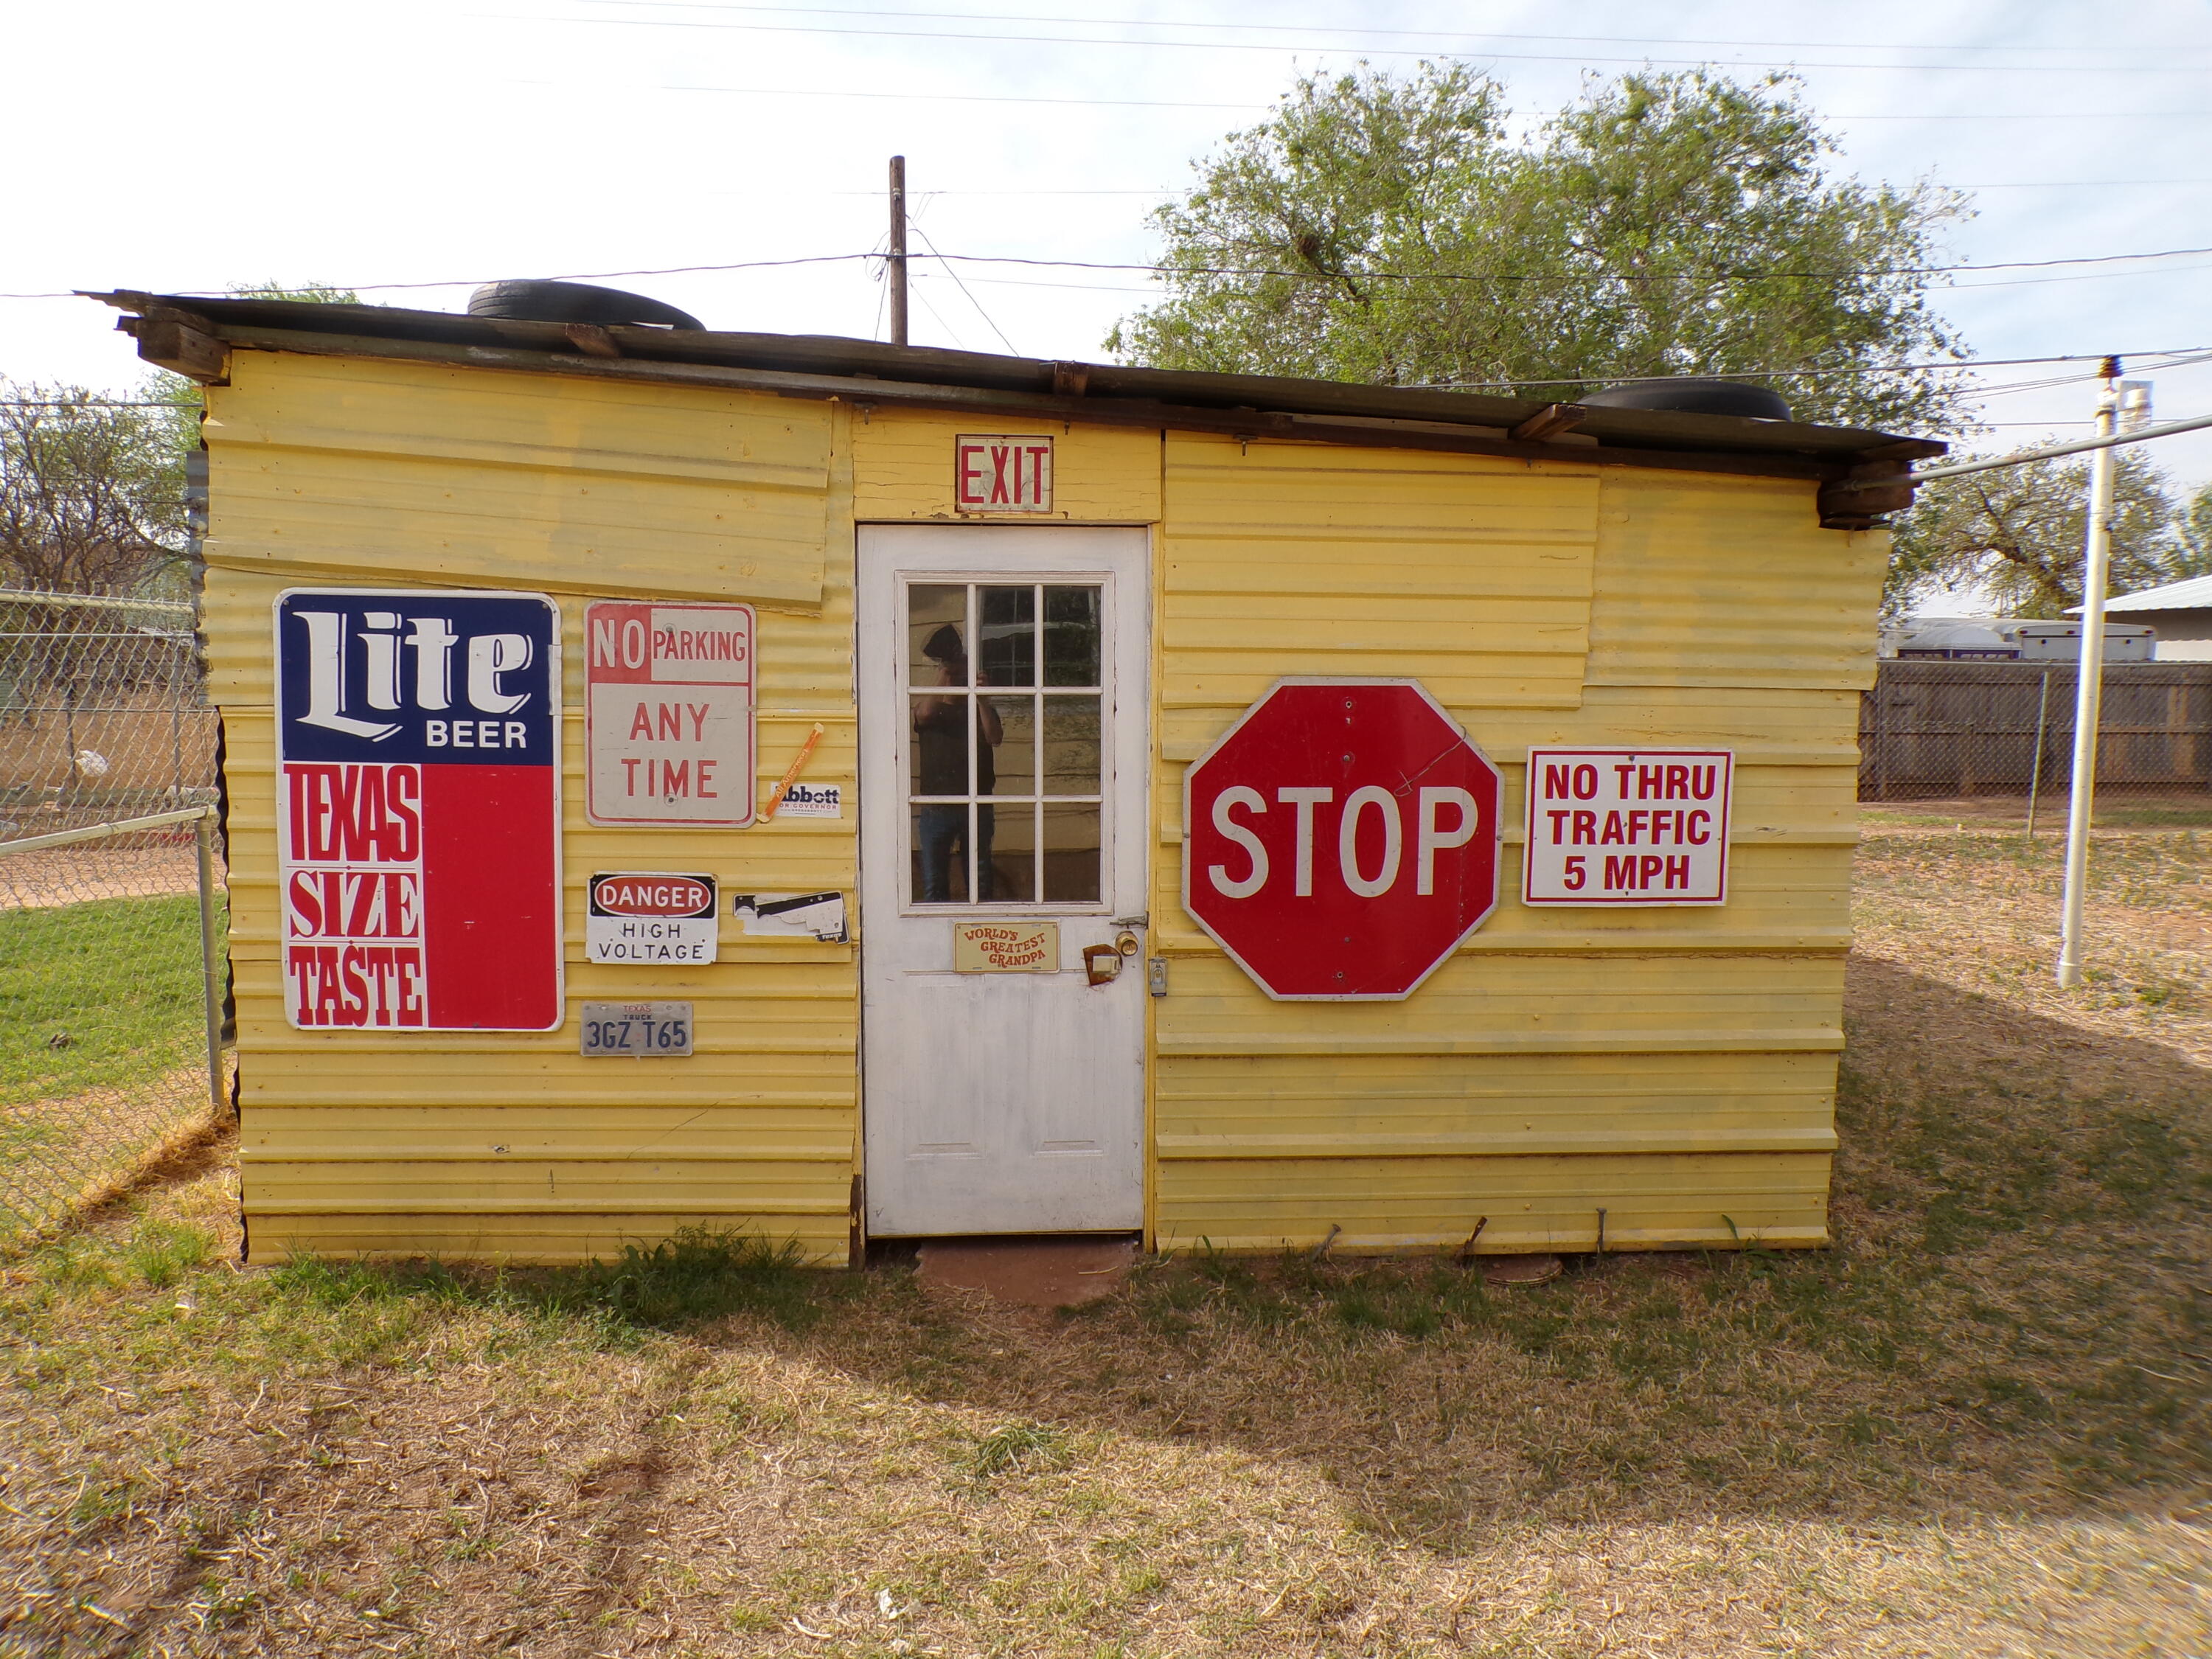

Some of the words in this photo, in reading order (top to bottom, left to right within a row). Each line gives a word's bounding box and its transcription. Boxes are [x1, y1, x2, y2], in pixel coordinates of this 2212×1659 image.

[961, 445, 1048, 504] EXIT
[593, 619, 646, 669] NO
[653, 630, 745, 661] PARKING
[292, 611, 533, 742] Lite
[425, 720, 526, 748] BEER
[629, 702, 710, 742] ANY
[621, 759, 718, 798] TIME
[1545, 764, 1598, 800] NO
[1614, 765, 1716, 800] THRU
[283, 765, 419, 862] TEXAS
[1547, 810, 1711, 845] TRAFFIC
[1208, 785, 1478, 899] STOP
[1564, 856, 1586, 891] 5
[1604, 855, 1690, 890] MPH
[289, 870, 419, 938] SIZE
[602, 885, 703, 908] DANGER
[622, 922, 680, 938] HIGH
[964, 928, 1018, 942] WORLD'S
[981, 933, 1046, 953] GREATEST
[599, 943, 703, 959] VOLTAGE
[989, 949, 1046, 968] GRANDPA
[289, 945, 423, 1027] TASTE
[588, 1020, 630, 1048] 3GZ
[642, 1020, 686, 1047] T65
